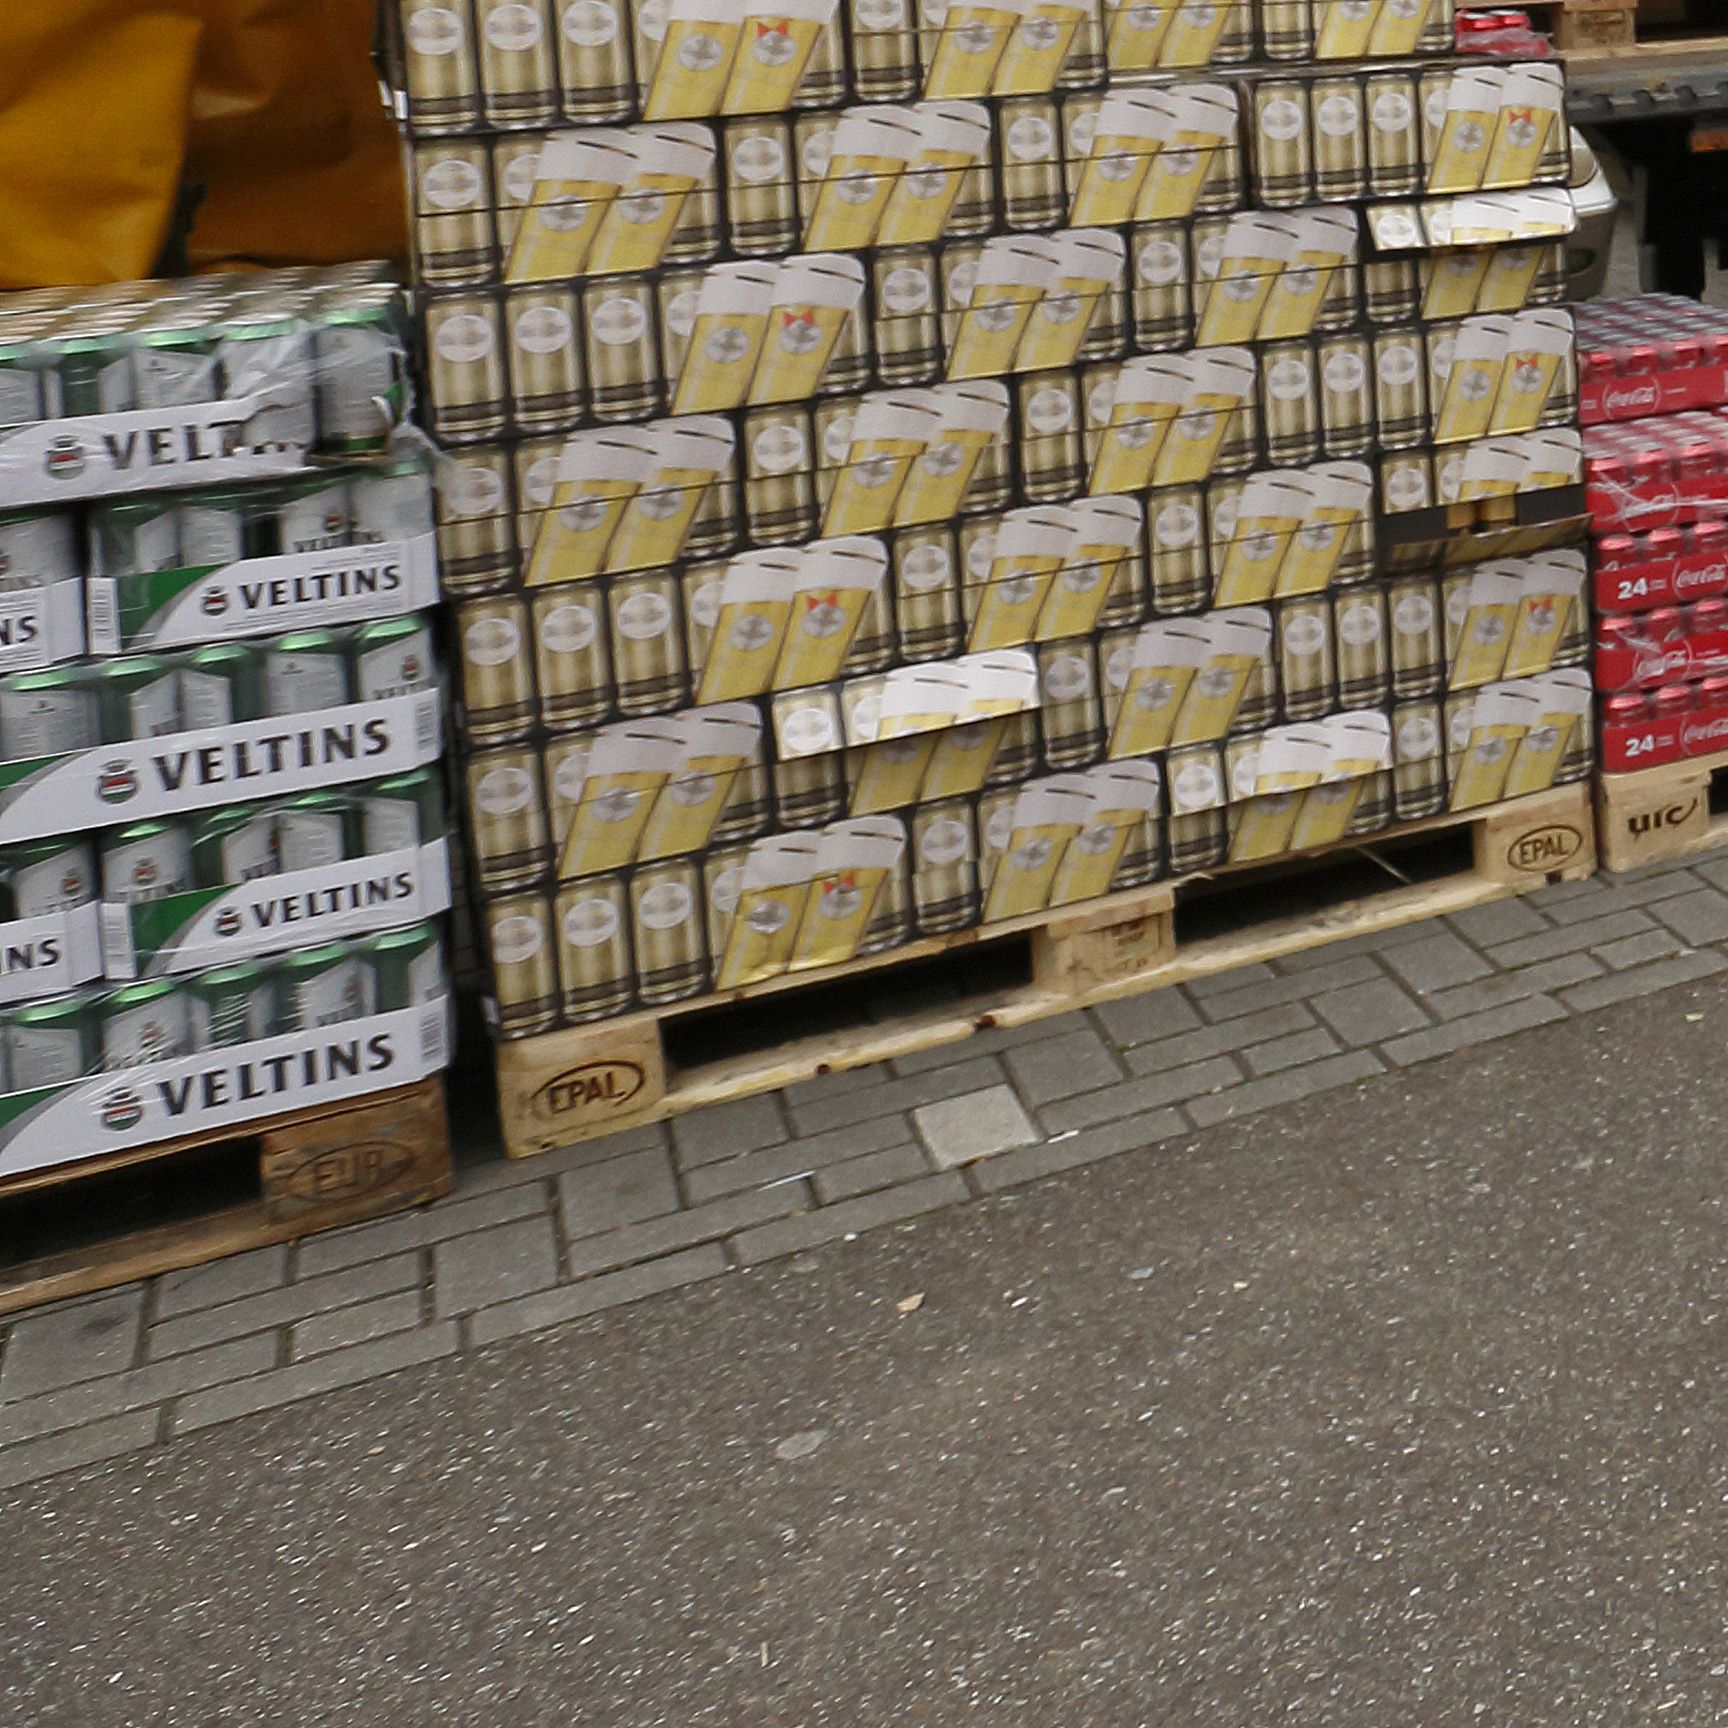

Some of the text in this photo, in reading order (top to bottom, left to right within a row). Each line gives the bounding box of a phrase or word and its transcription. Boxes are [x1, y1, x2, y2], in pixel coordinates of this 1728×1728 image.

[102, 419, 305, 471] VELT
[238, 565, 400, 610] VELTINS
[1617, 577, 1649, 601] 24
[153, 719, 390, 792] VELTINS
[1625, 734, 1655, 758] 24
[1520, 834, 1571, 861] EPAL
[251, 872, 413, 929] VELTINS
[157, 1034, 394, 1117] VELTINS
[546, 1073, 625, 1112] EPAL
